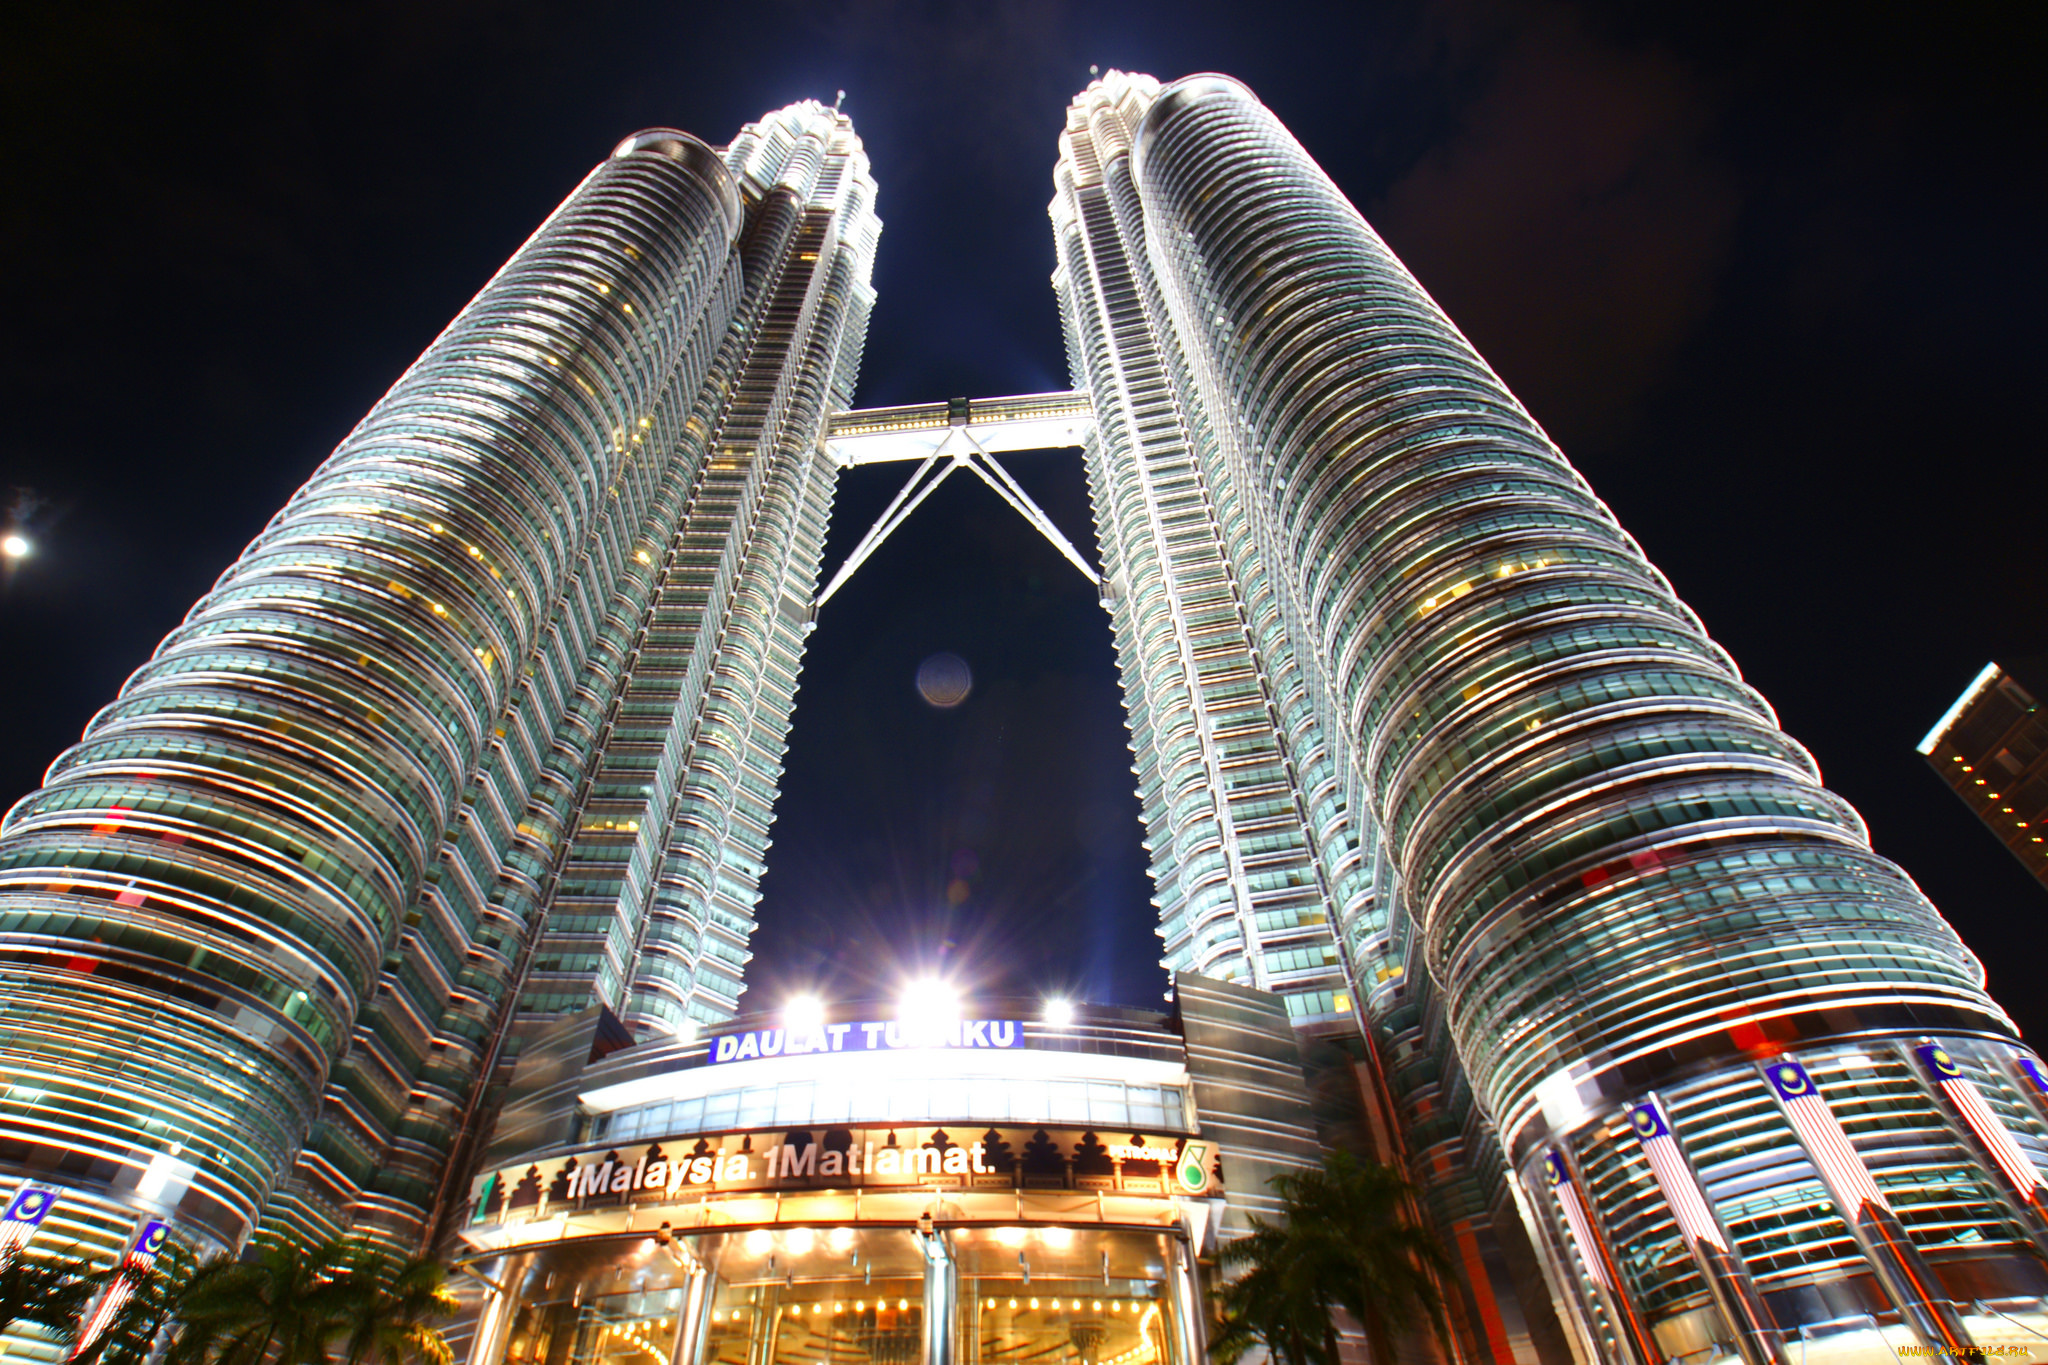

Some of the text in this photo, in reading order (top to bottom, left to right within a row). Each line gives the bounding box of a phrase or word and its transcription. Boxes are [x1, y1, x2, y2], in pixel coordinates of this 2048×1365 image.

[716, 1020, 1014, 1062] DAULAT TUNKU
[567, 1141, 996, 1199] 1Malaysia. 1Matlamat.
[1109, 1145, 1178, 1161] PETRONAS
